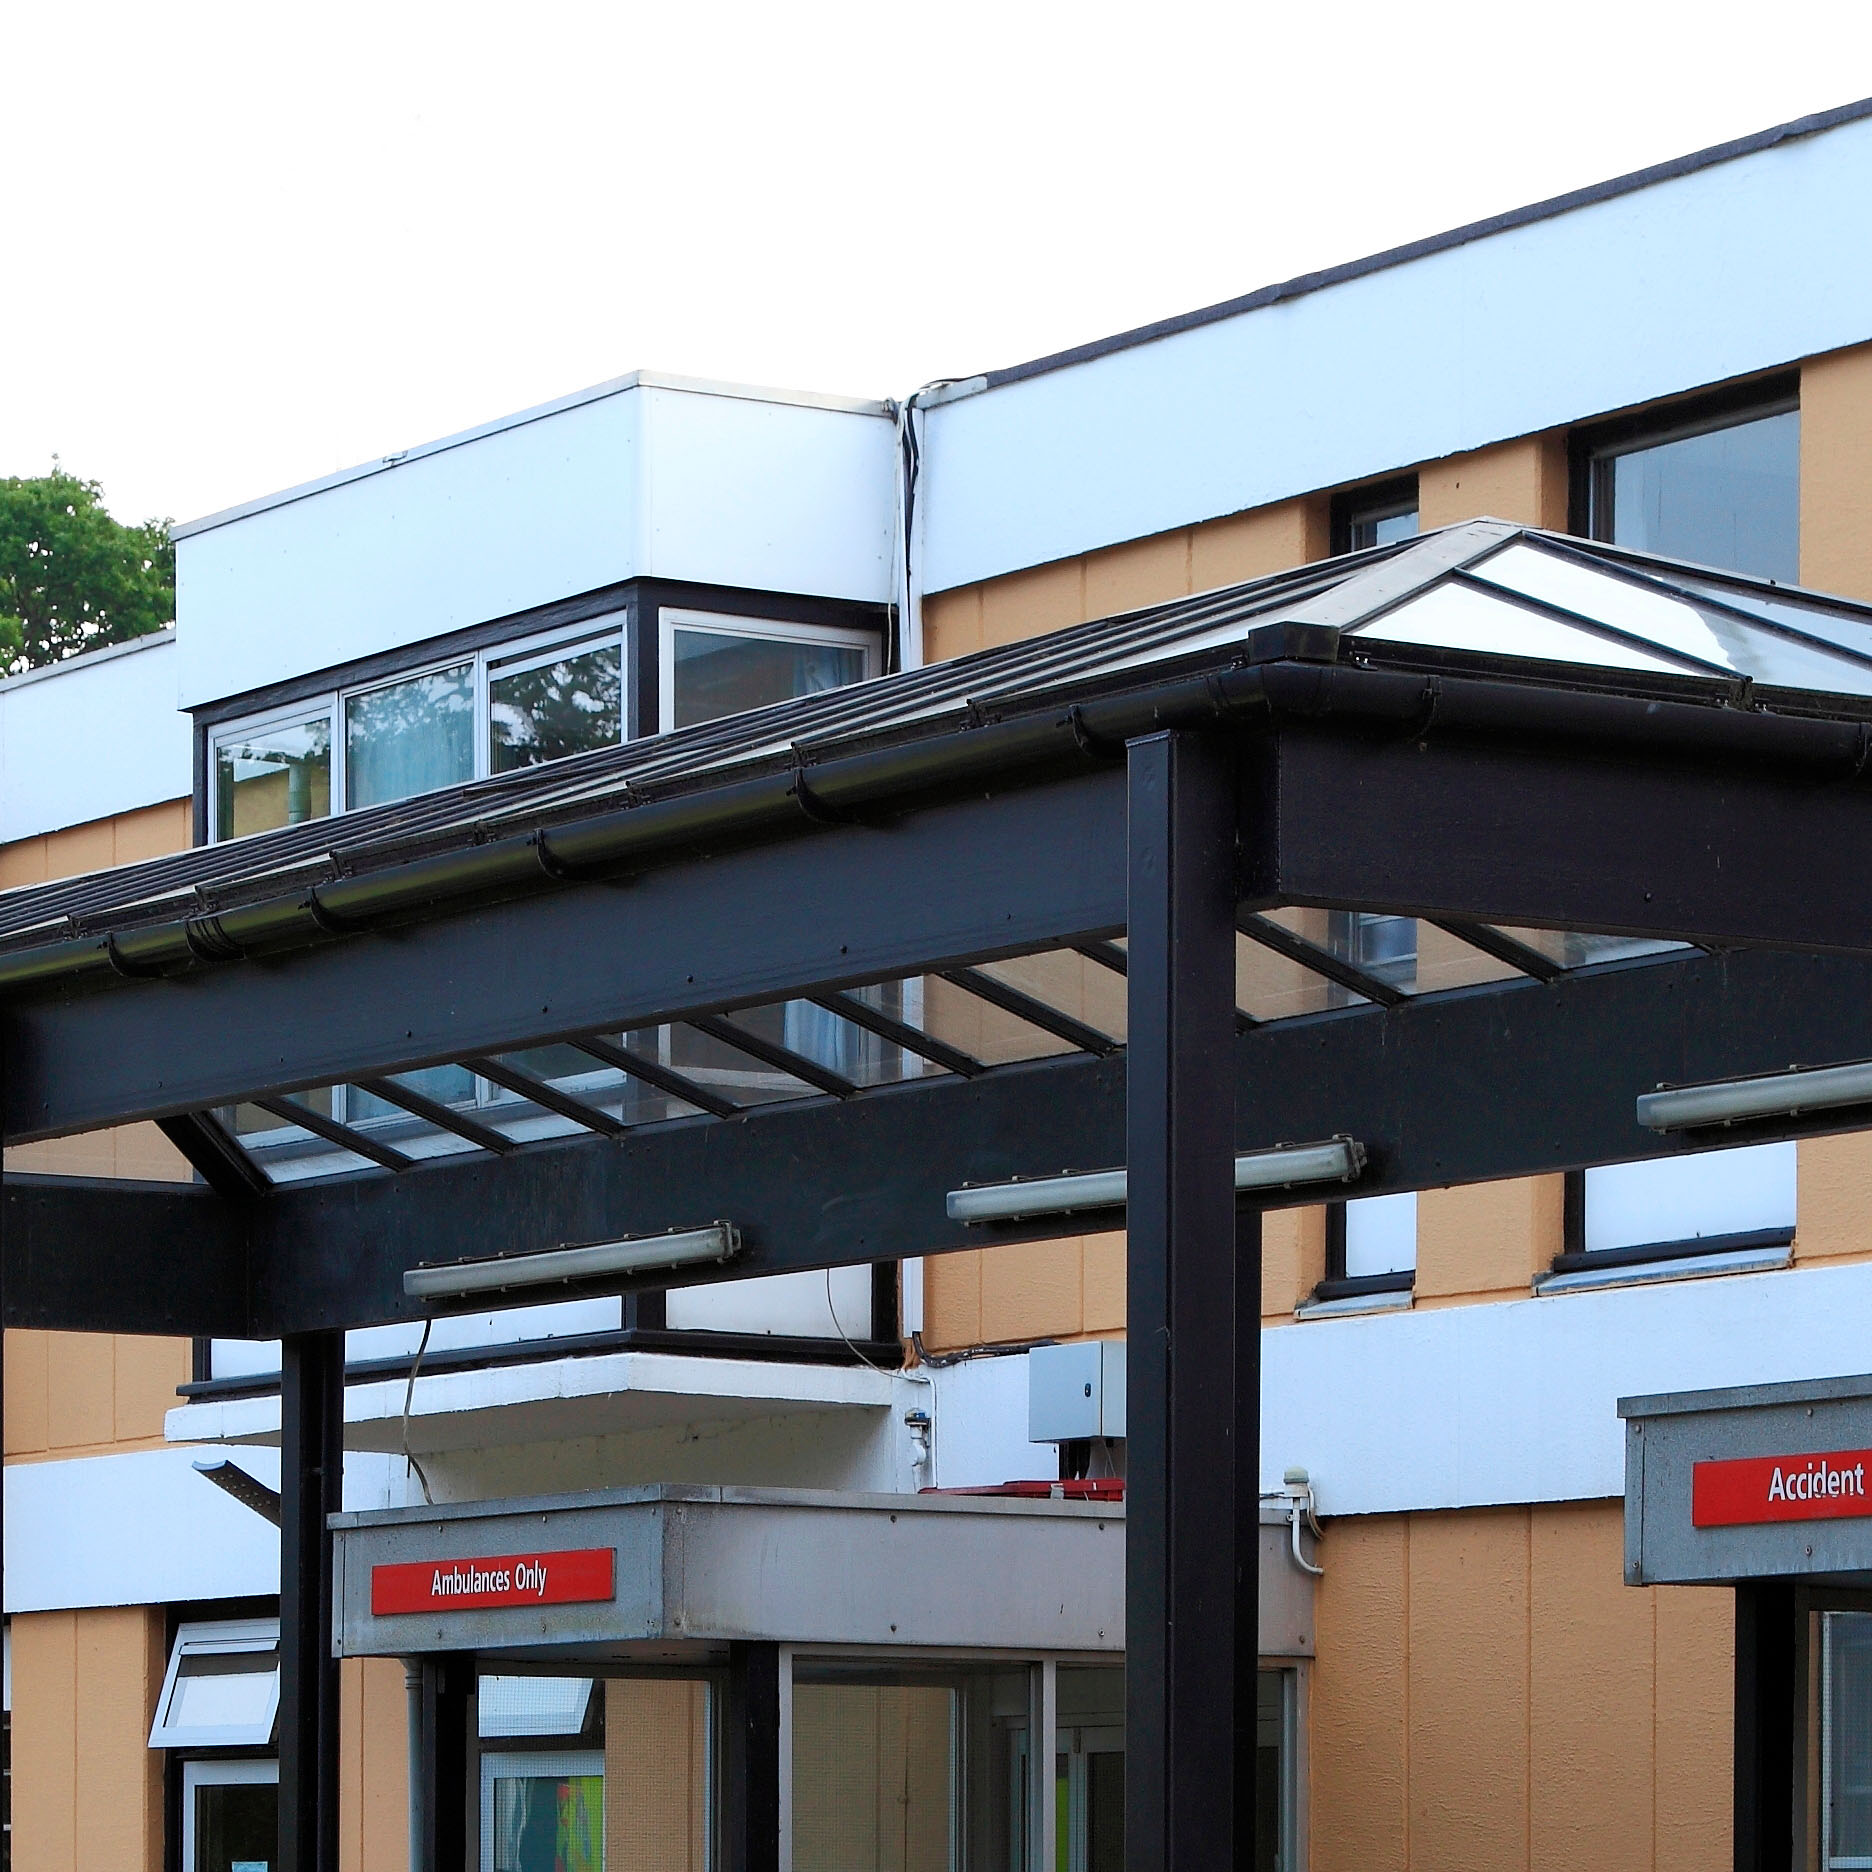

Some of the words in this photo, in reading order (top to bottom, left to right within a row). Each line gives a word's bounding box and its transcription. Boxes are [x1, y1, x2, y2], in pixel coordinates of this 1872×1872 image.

[1768, 1461, 1865, 1503] Accident
[430, 1562, 512, 1598] Ambulances
[514, 1559, 548, 1595] Only
